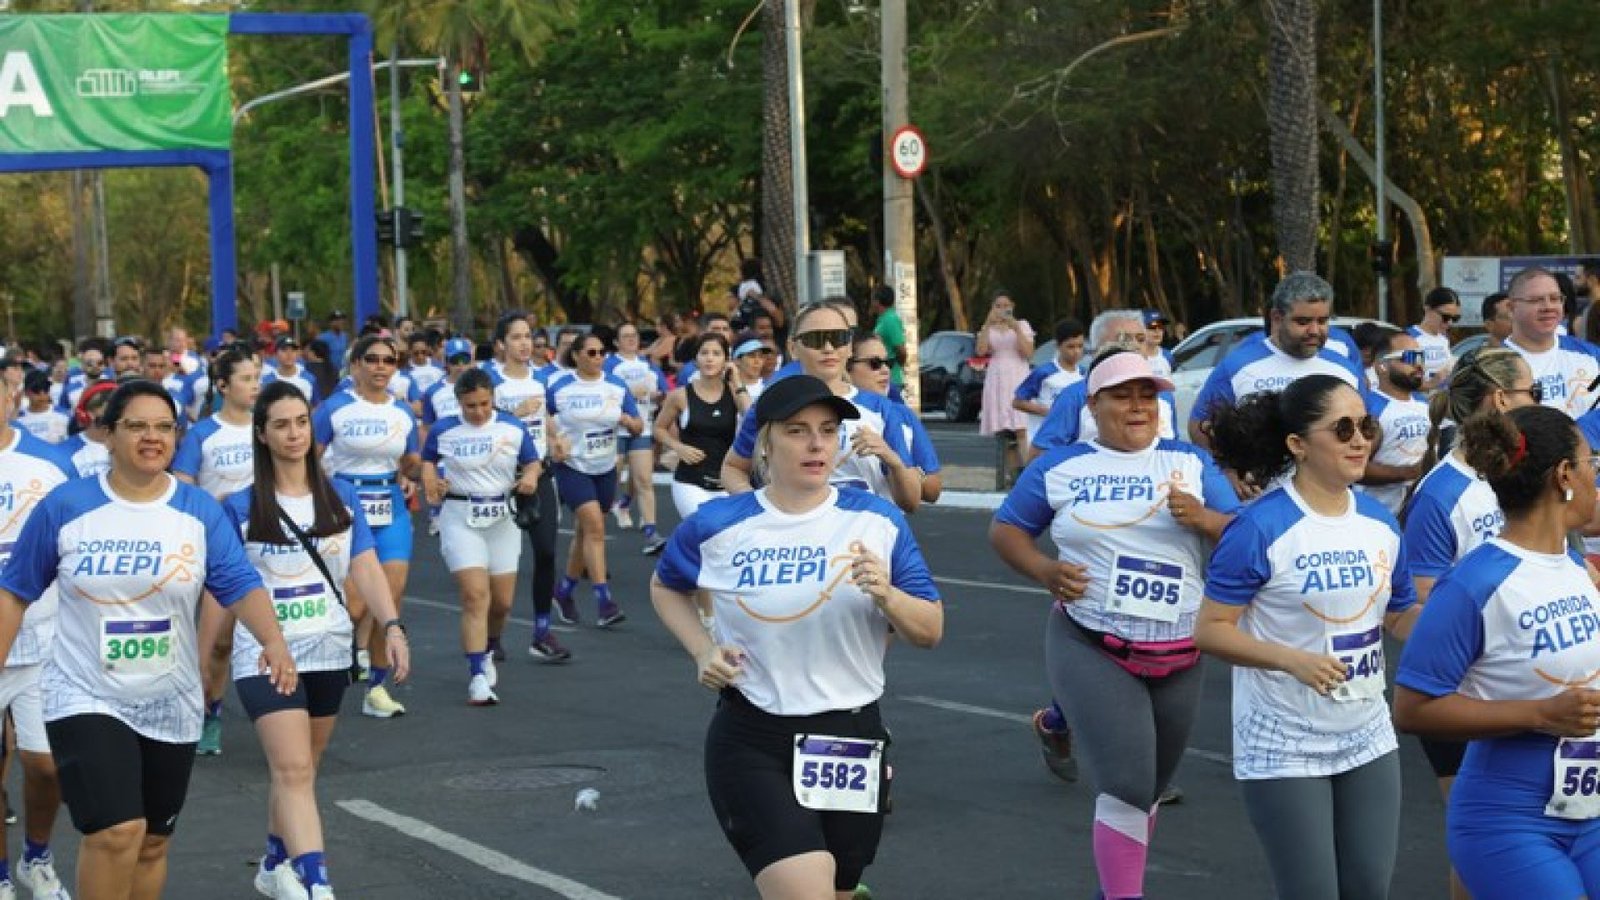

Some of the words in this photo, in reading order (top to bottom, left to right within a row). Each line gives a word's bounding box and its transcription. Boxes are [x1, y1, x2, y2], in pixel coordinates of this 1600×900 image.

[899, 139, 919, 157] 60
[1541, 382, 1567, 400] EPI
[214, 451, 252, 468] ALEP
[1068, 475, 1153, 491] CORRIDA
[1072, 484, 1154, 507] ALEPI
[77, 540, 163, 554] CORRIDA
[732, 546, 826, 567] CORRIDA
[73, 555, 162, 577] ALEPI
[1295, 549, 1369, 570] CORRIDA
[736, 559, 826, 589] ALEPI
[1300, 565, 1374, 594] ALEPI
[1114, 574, 1180, 605] 5095
[276, 599, 327, 622] 3086
[1518, 594, 1592, 631] CORRIDA
[107, 635, 171, 661] 3096
[801, 761, 867, 791] 5582
[1562, 766, 1600, 797] 56
